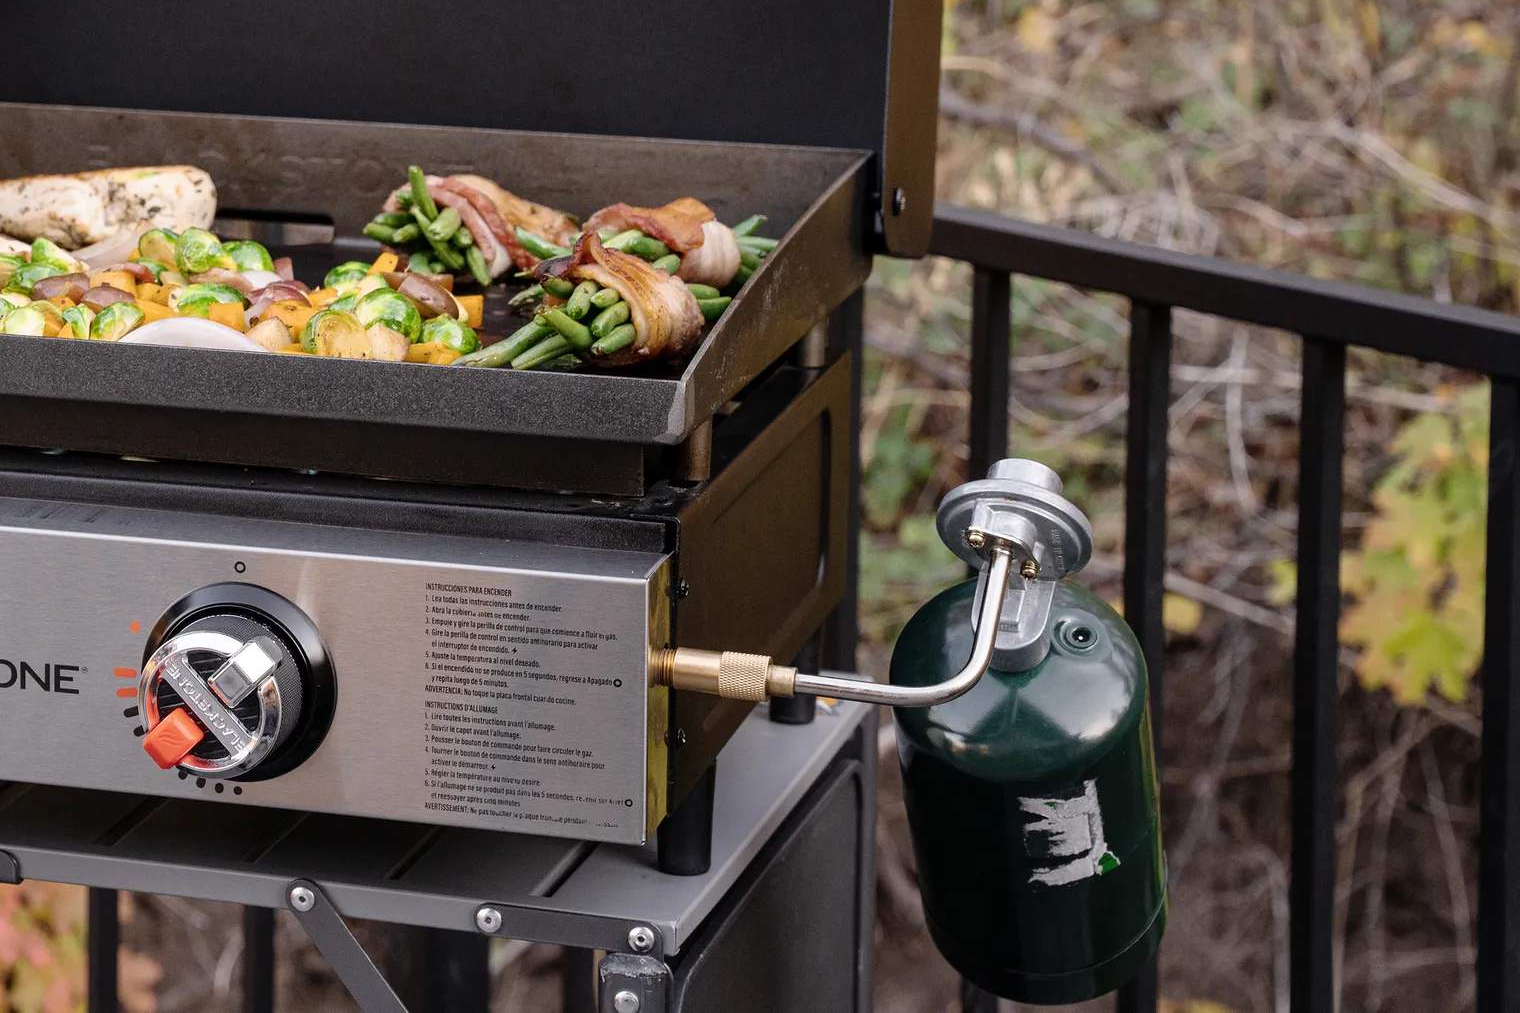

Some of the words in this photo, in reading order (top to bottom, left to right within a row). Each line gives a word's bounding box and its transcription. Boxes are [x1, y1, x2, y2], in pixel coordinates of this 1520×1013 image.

[483, 587, 511, 597] ENCENDER
[442, 595, 458, 603] todas
[509, 601, 525, 610] antes
[504, 623, 524, 632] control
[477, 632, 498, 641] control
[490, 667, 514, 679] produce
[495, 690, 511, 701] placa
